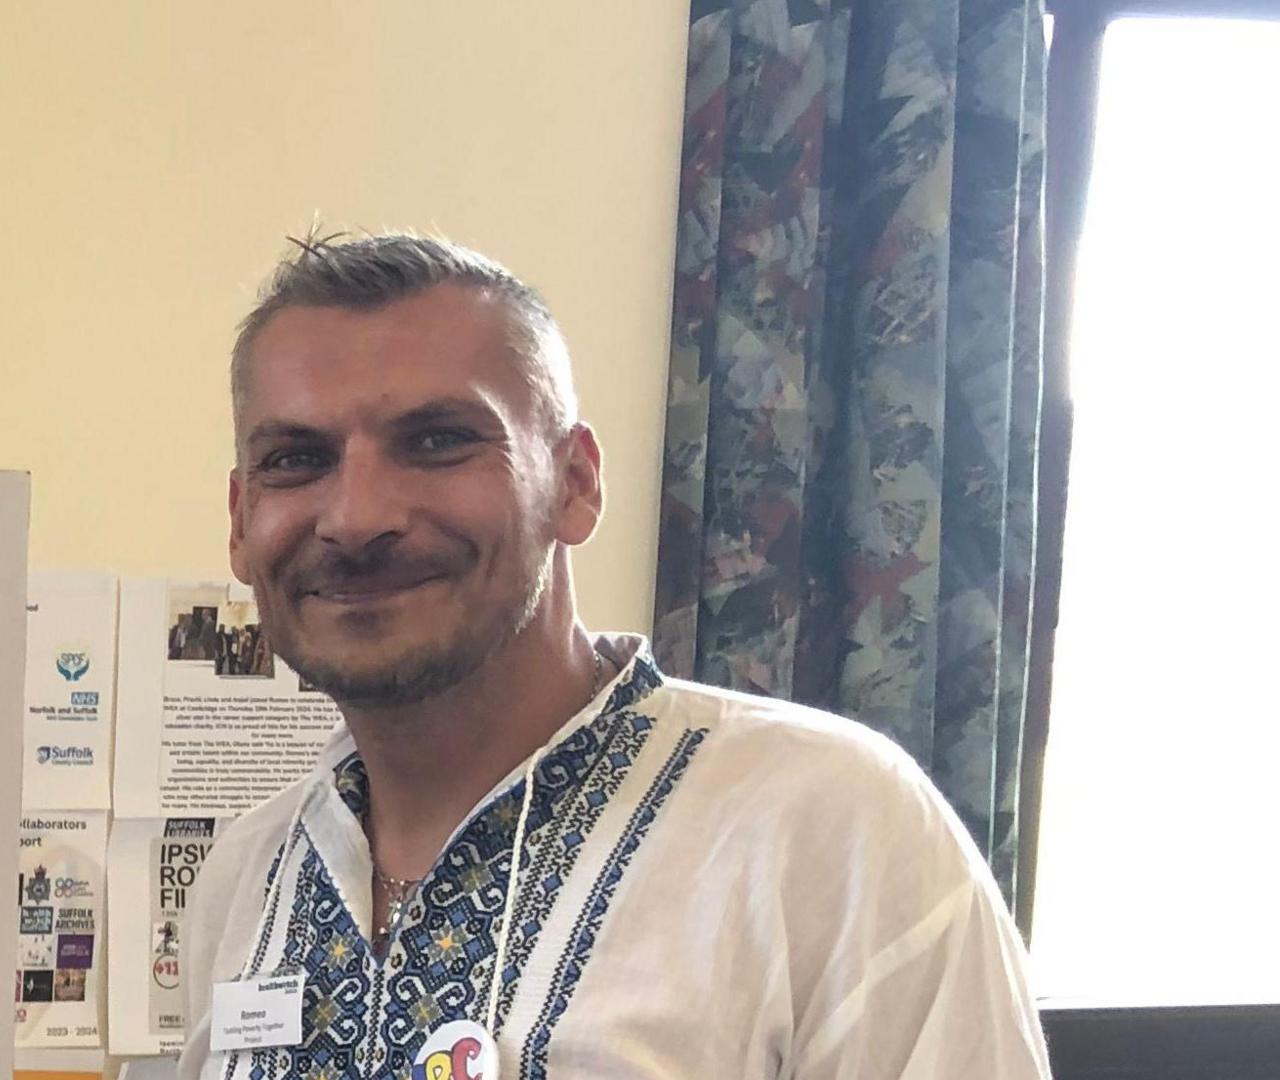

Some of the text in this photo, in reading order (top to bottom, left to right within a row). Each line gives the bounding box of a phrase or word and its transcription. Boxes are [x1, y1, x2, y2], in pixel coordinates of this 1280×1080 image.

[51, 746, 93, 760] Suffolk
[160, 865, 200, 888] RO
[240, 1009, 267, 1021] Romeo
